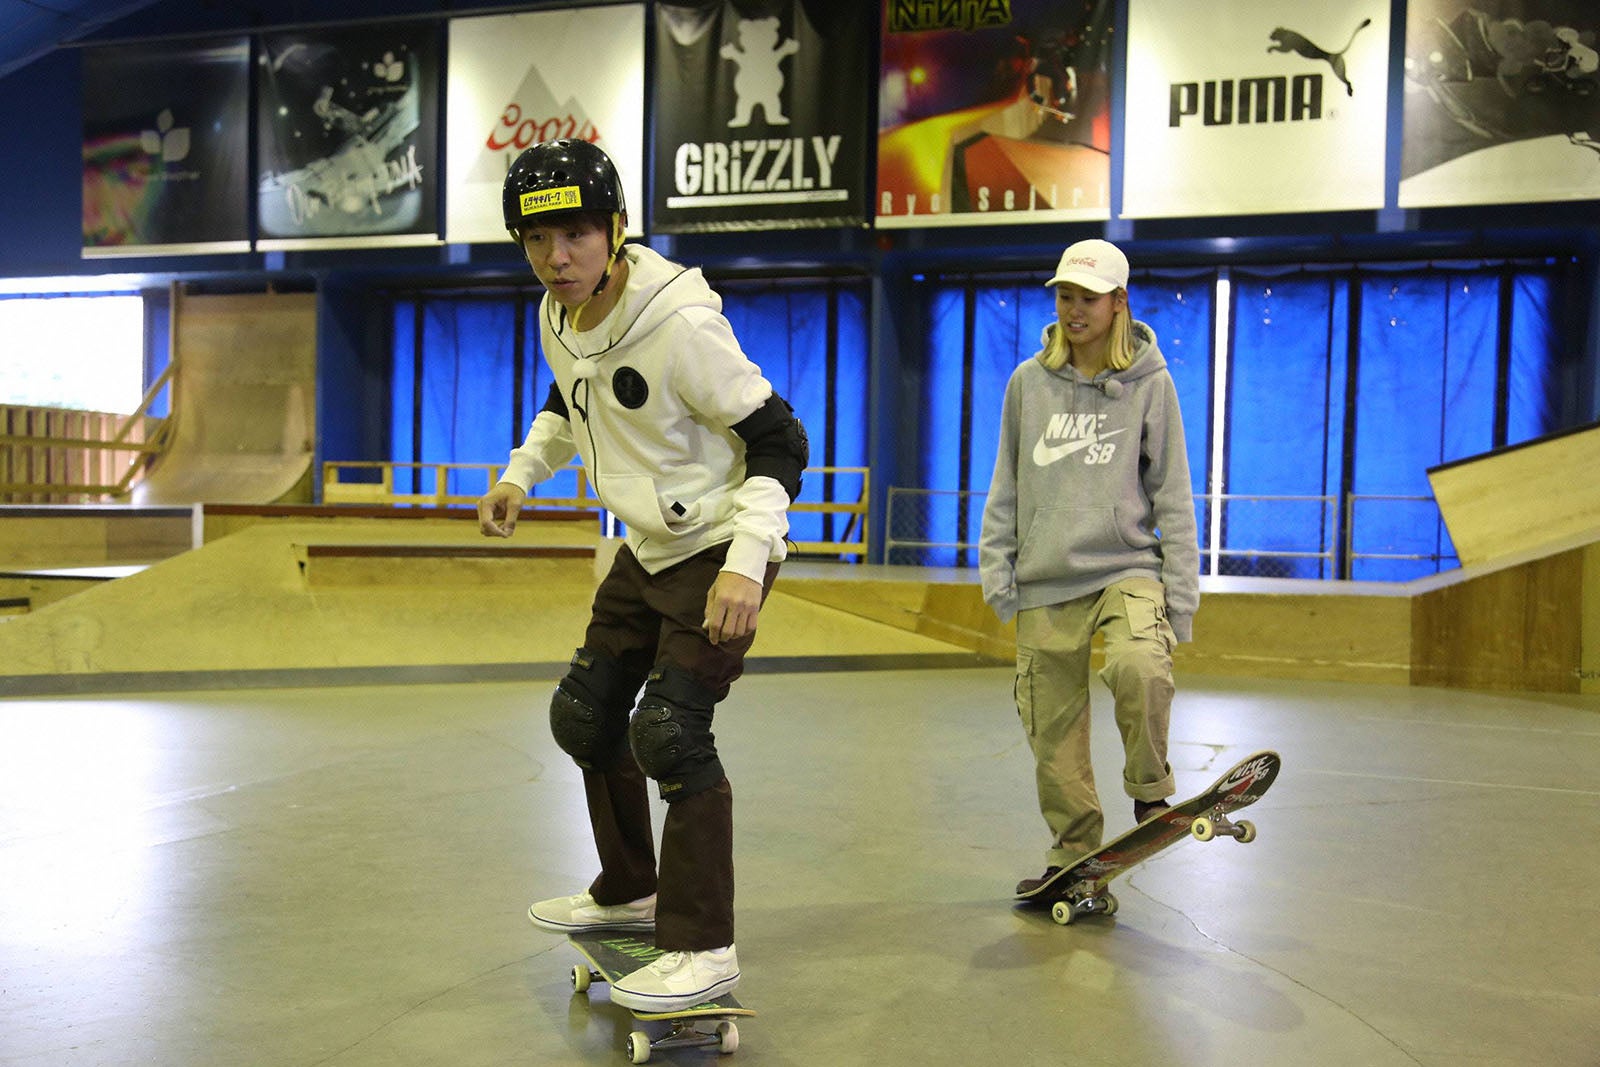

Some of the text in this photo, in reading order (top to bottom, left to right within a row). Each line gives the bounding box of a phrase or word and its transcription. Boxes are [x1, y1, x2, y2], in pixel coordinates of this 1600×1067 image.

[1169, 74, 1323, 127] PUMA
[486, 103, 601, 150] Coors
[881, 191, 941, 215] Ryo
[1045, 413, 1108, 441] NIKE
[1084, 443, 1116, 465] SB
[1229, 755, 1269, 781] NIKE
